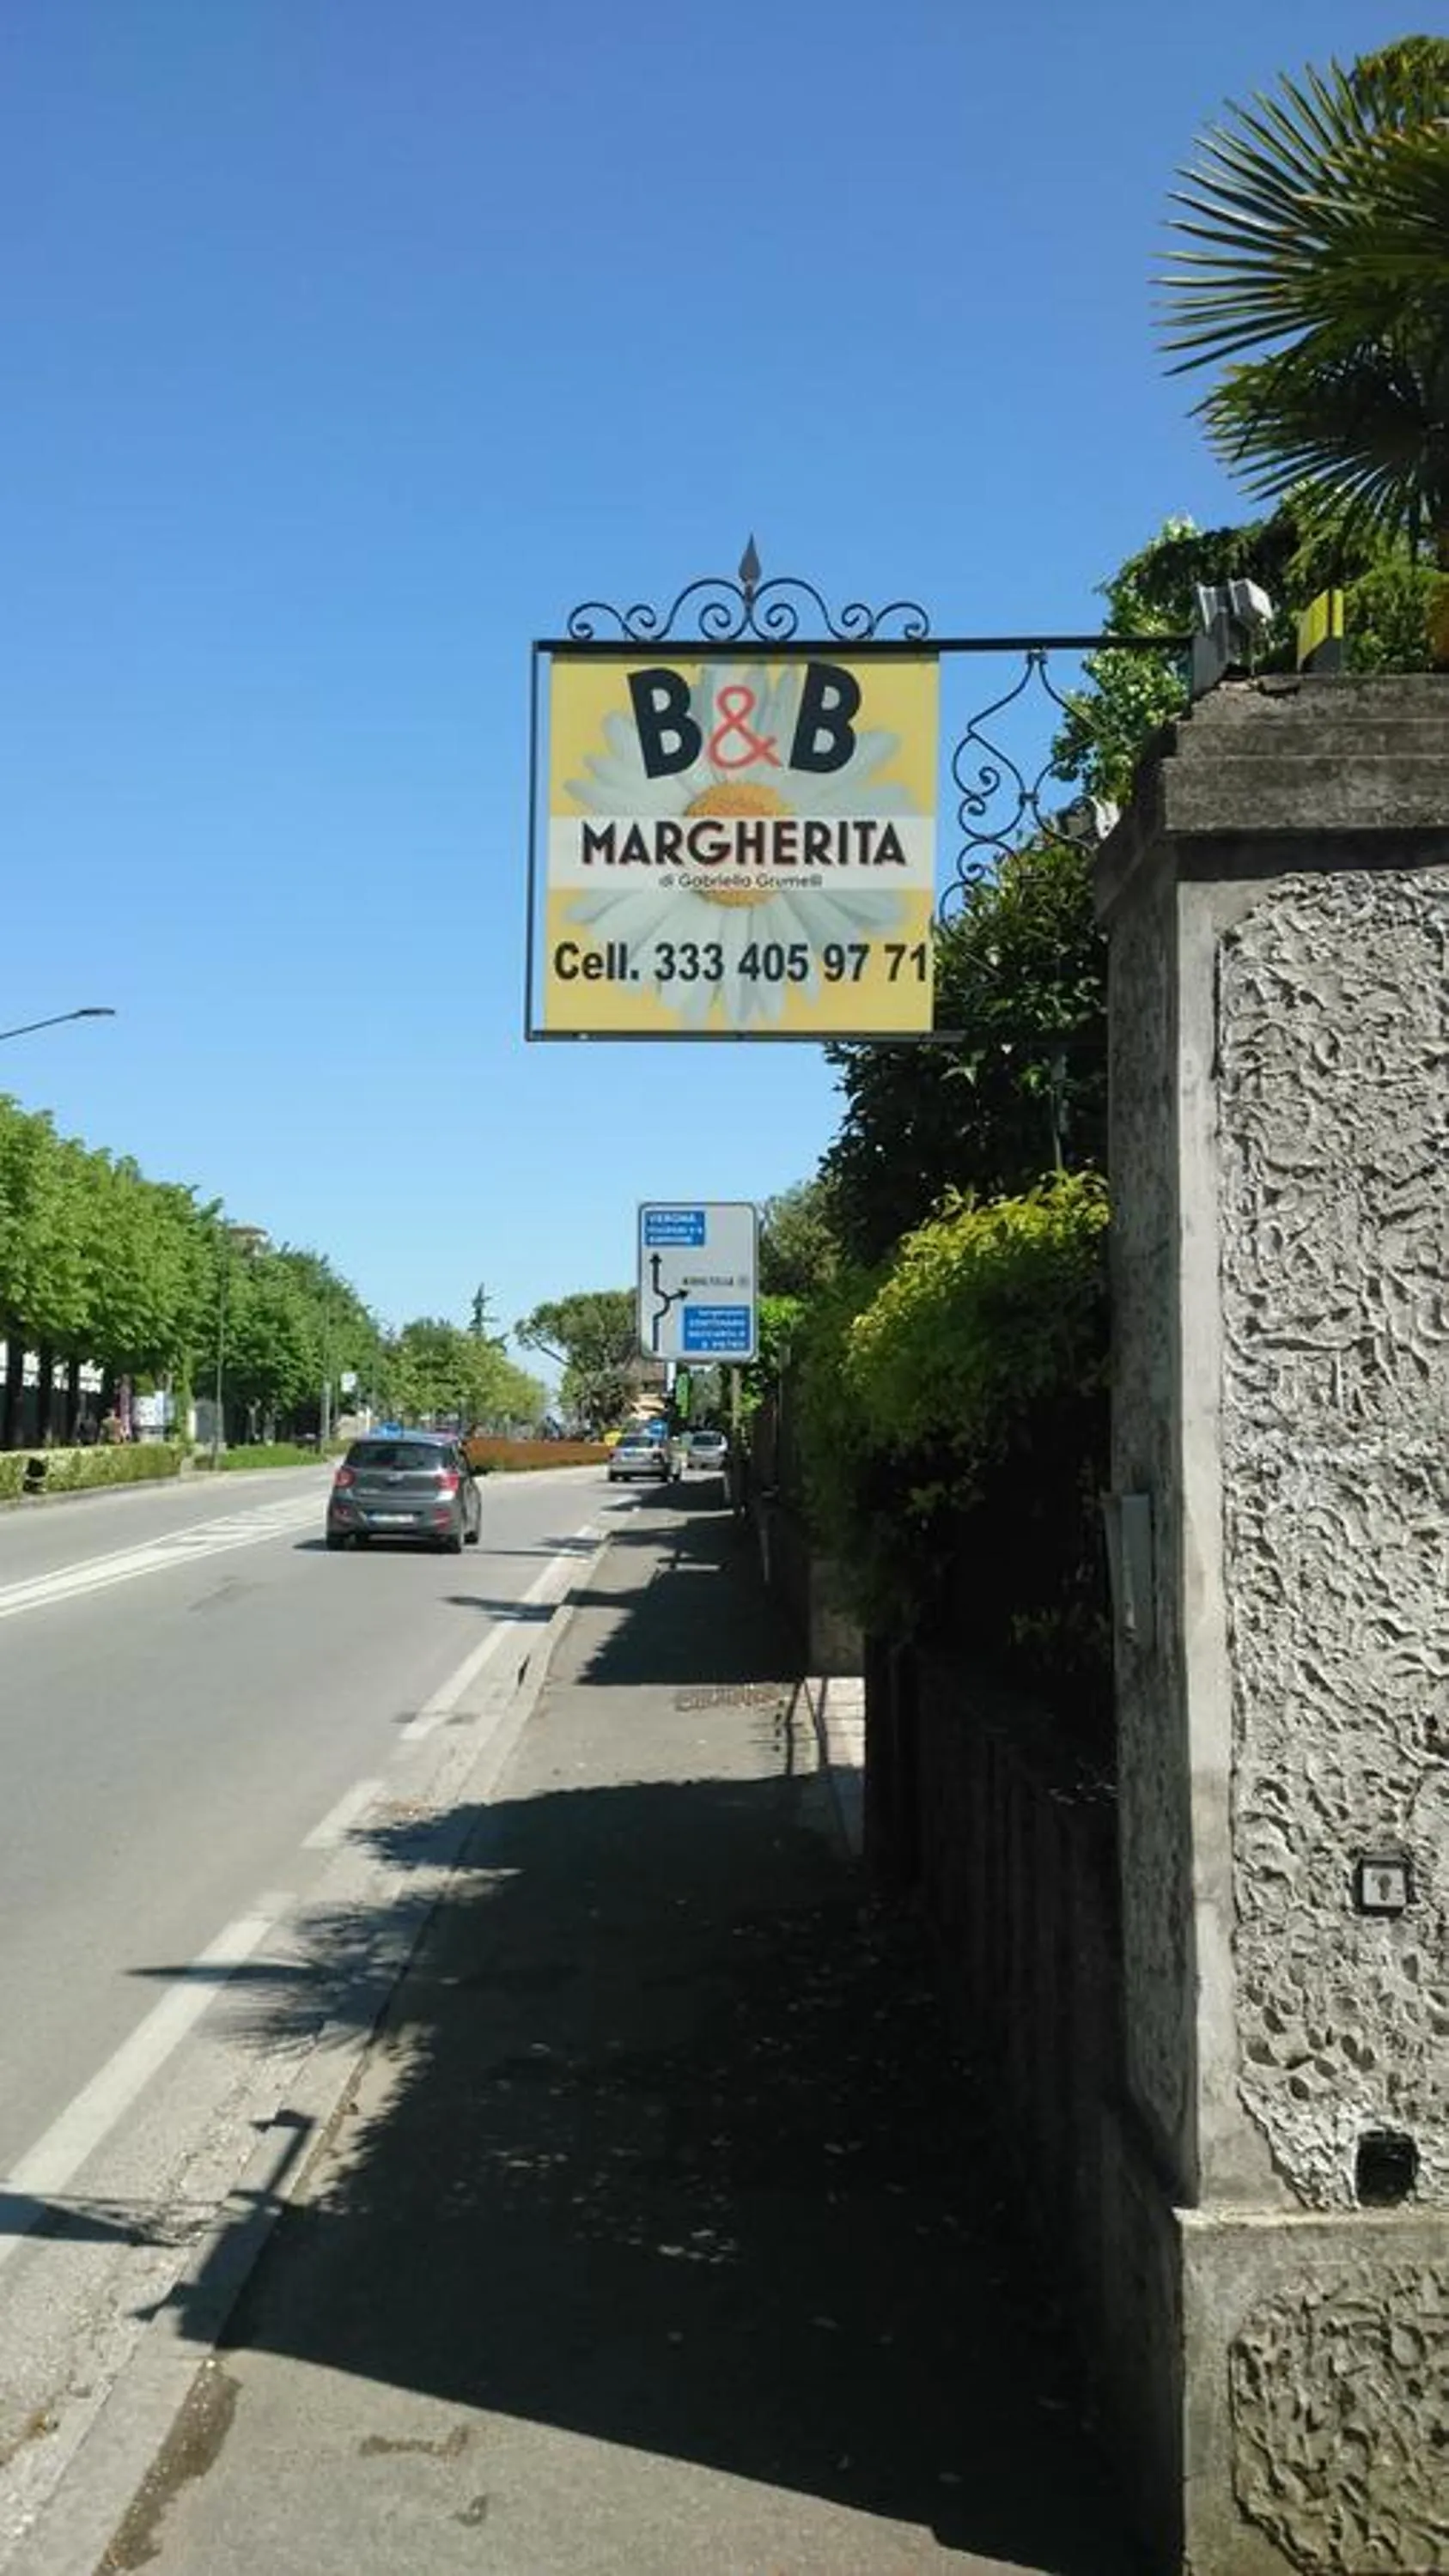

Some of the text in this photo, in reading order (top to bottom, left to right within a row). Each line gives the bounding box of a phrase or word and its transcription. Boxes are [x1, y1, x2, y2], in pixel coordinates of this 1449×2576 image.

[627, 661, 861, 779] B&B
[581, 819, 906, 866] MARGHERITA
[658, 872, 675, 888] di
[679, 872, 752, 889] Gabriella
[554, 941, 927, 982] Cell. 333 405 97 71
